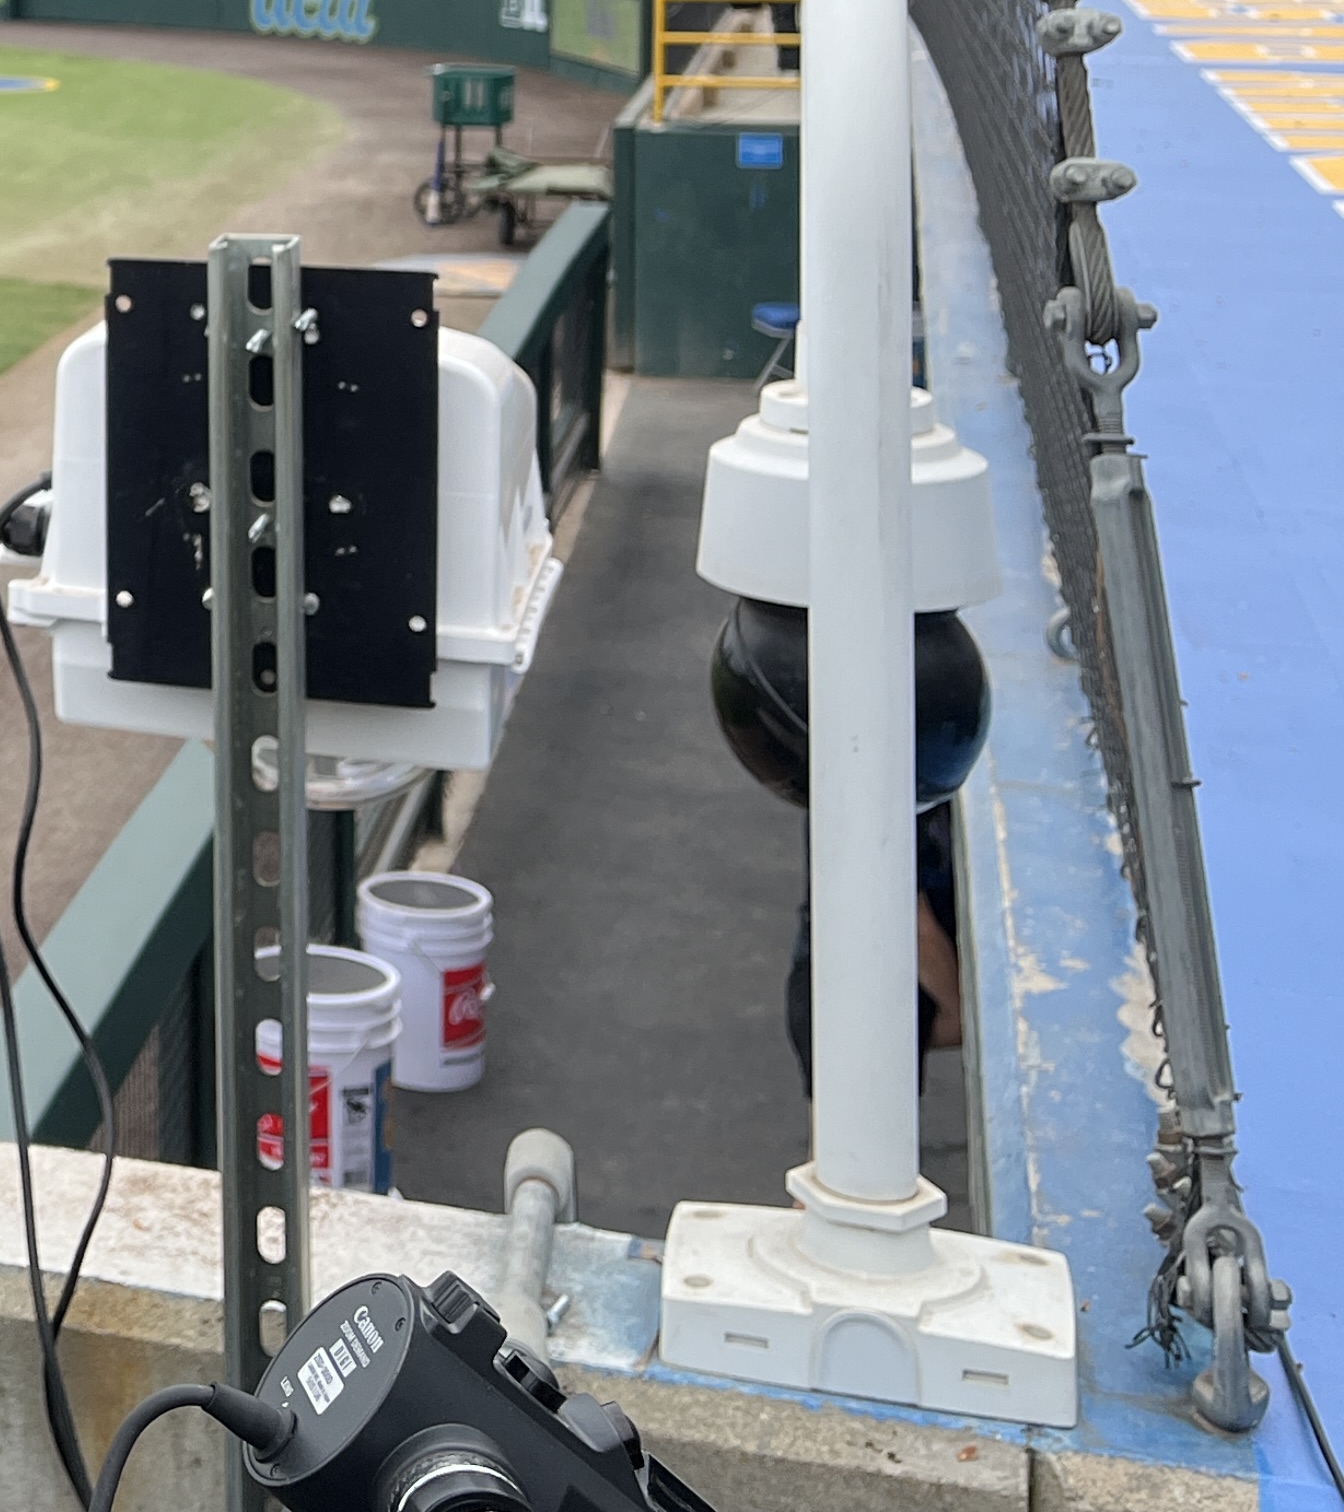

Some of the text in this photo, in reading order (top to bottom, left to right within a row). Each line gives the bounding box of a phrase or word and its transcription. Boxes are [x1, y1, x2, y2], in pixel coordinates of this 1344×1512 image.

[340, 1319, 371, 1368] ZOOM DEMAND
[354, 1305, 384, 1353] Canon
[333, 1345, 352, 1371] DIGI
